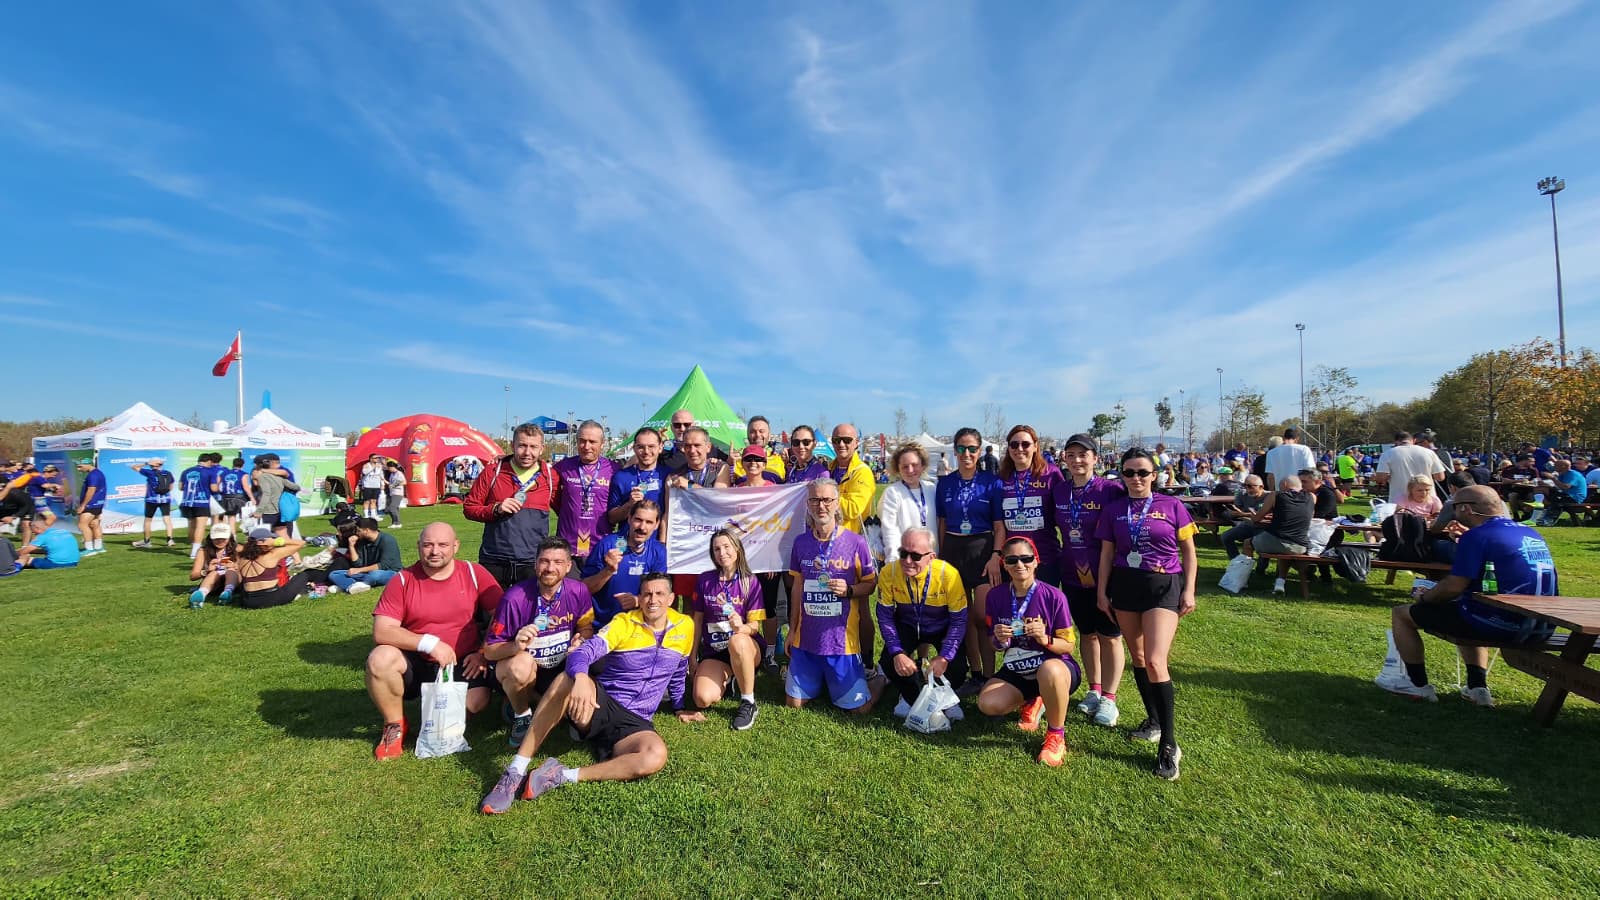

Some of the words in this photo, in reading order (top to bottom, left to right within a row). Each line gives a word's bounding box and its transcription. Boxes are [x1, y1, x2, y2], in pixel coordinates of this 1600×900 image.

[1004, 510, 1012, 518] D
[806, 592, 812, 601] B
[814, 593, 838, 602] 13415
[1006, 663, 1015, 671] B
